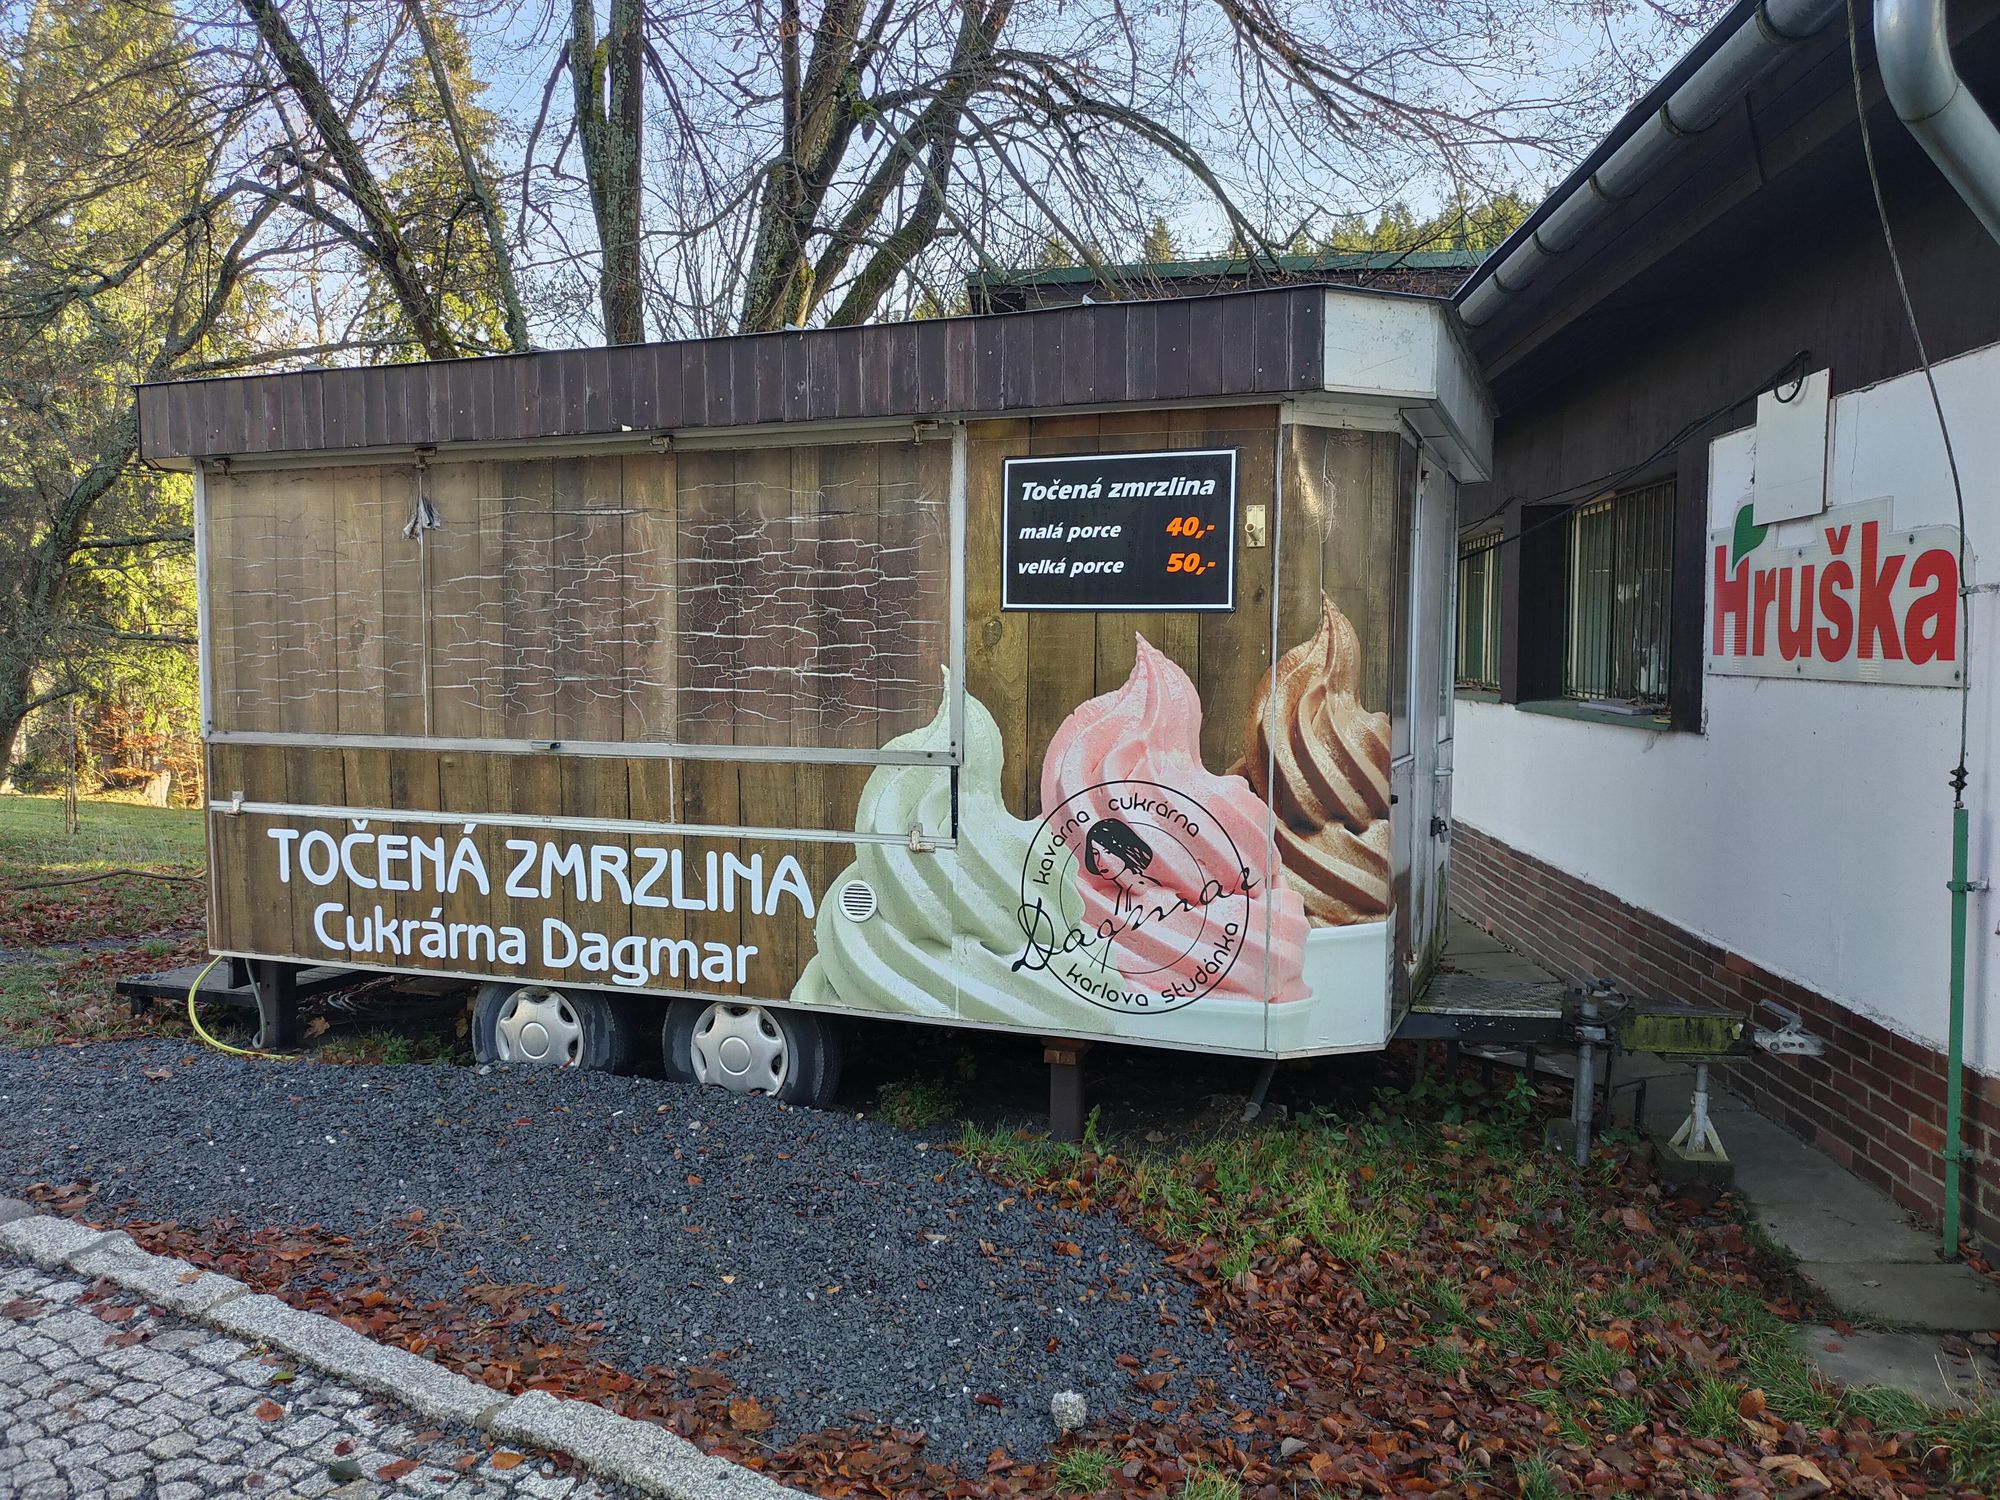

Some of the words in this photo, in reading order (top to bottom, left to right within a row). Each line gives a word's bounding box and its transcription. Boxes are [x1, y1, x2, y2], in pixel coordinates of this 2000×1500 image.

[1019, 522, 1063, 539] malá
[1067, 523, 1122, 542] porce
[1166, 516, 1215, 539] 40,-
[1021, 476, 1103, 500] Točená
[1108, 476, 1215, 498] zmrzlina
[1018, 556, 1066, 574] velká
[1070, 560, 1124, 577] porce
[1166, 553, 1216, 575] 50,-
[1713, 520, 1959, 665] Hruška
[267, 820, 490, 895] TOČENÁ
[504, 839, 815, 919] ZMRZLINA
[1033, 810, 1090, 885] kavárna
[1108, 793, 1199, 837] cukrárna
[314, 902, 526, 966] Cukrárna
[542, 917, 759, 987] Dagmar
[1011, 867, 1261, 974] Dagmar
[1066, 963, 1149, 1006] karlova
[1161, 922, 1239, 1003] studánka
